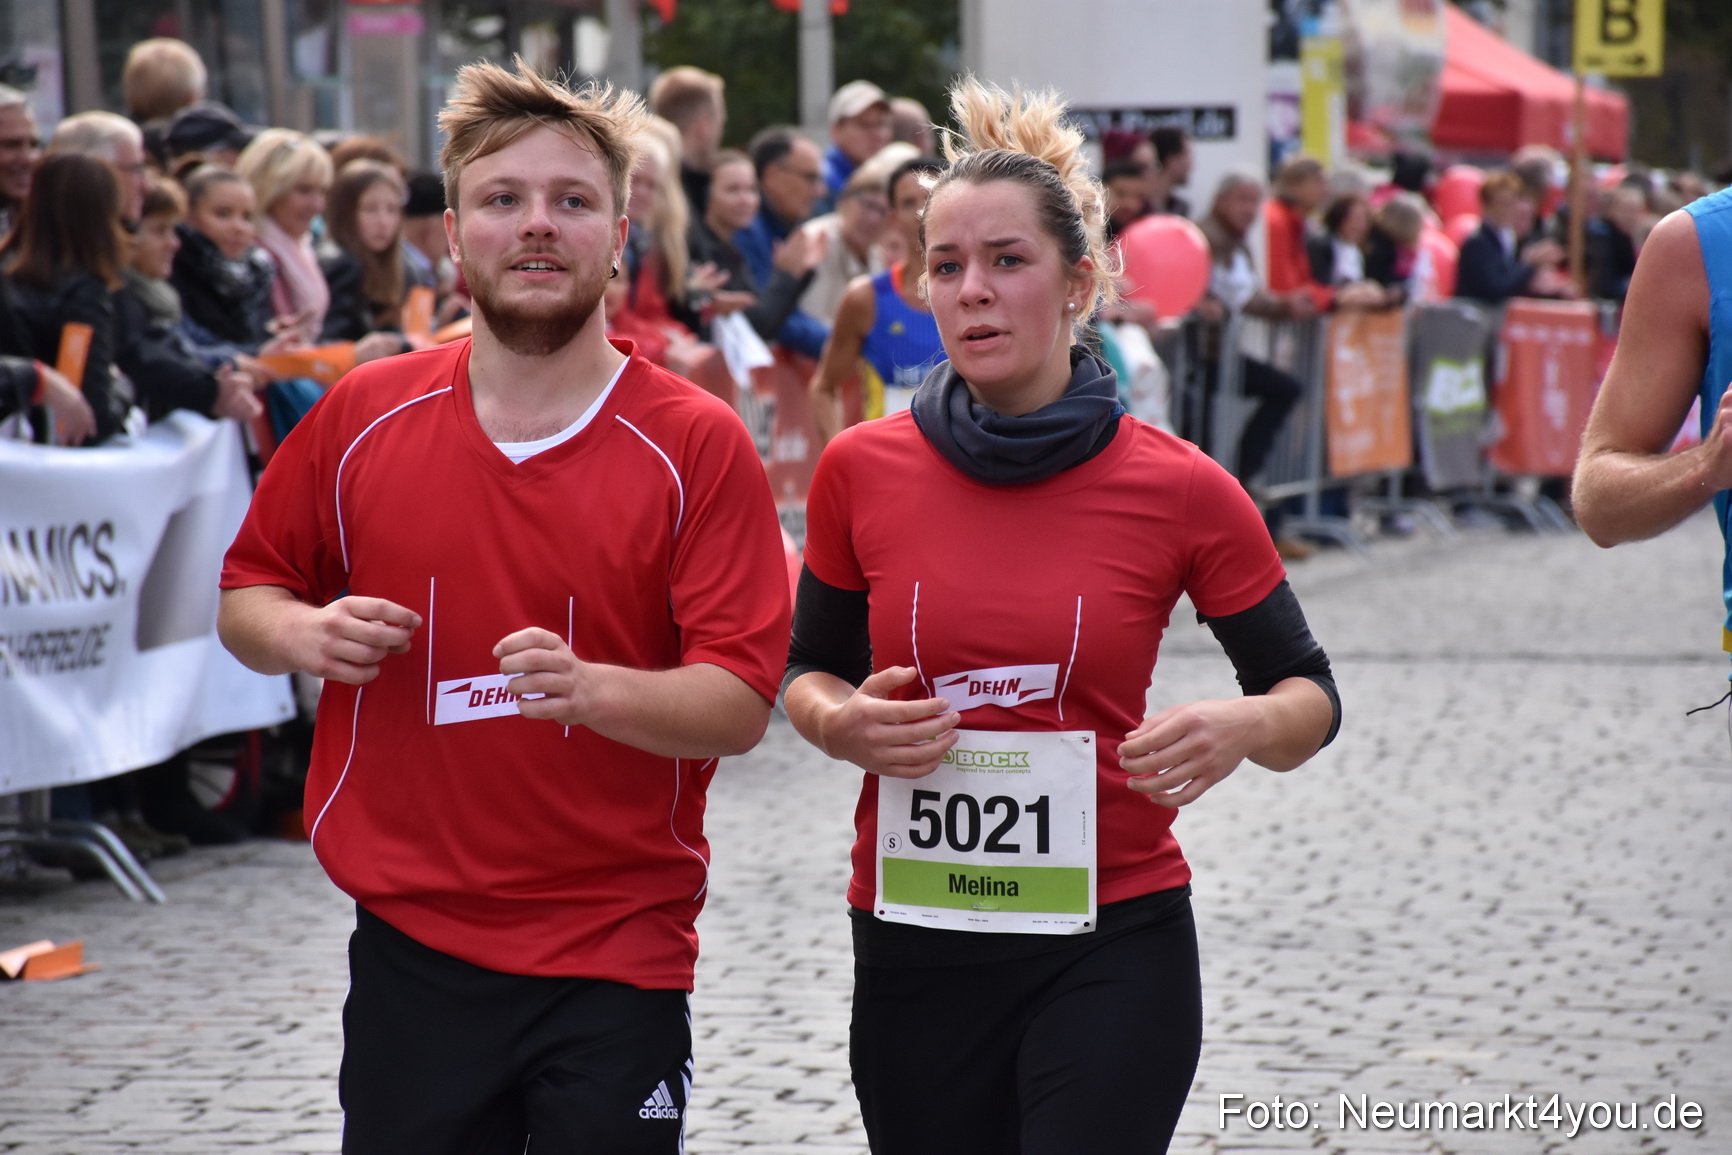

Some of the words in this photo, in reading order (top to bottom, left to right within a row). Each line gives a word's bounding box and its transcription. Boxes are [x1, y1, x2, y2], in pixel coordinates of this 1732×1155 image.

[1601, 0, 1639, 44] B
[968, 677, 1022, 697] DEHN
[956, 749, 1030, 768] BOCK
[956, 766, 978, 774] inspired
[979, 766, 986, 775] by
[908, 788, 1050, 854] 5021
[888, 837, 896, 849] S
[948, 873, 1019, 897] Melina
[638, 1104, 679, 1120] adidas
